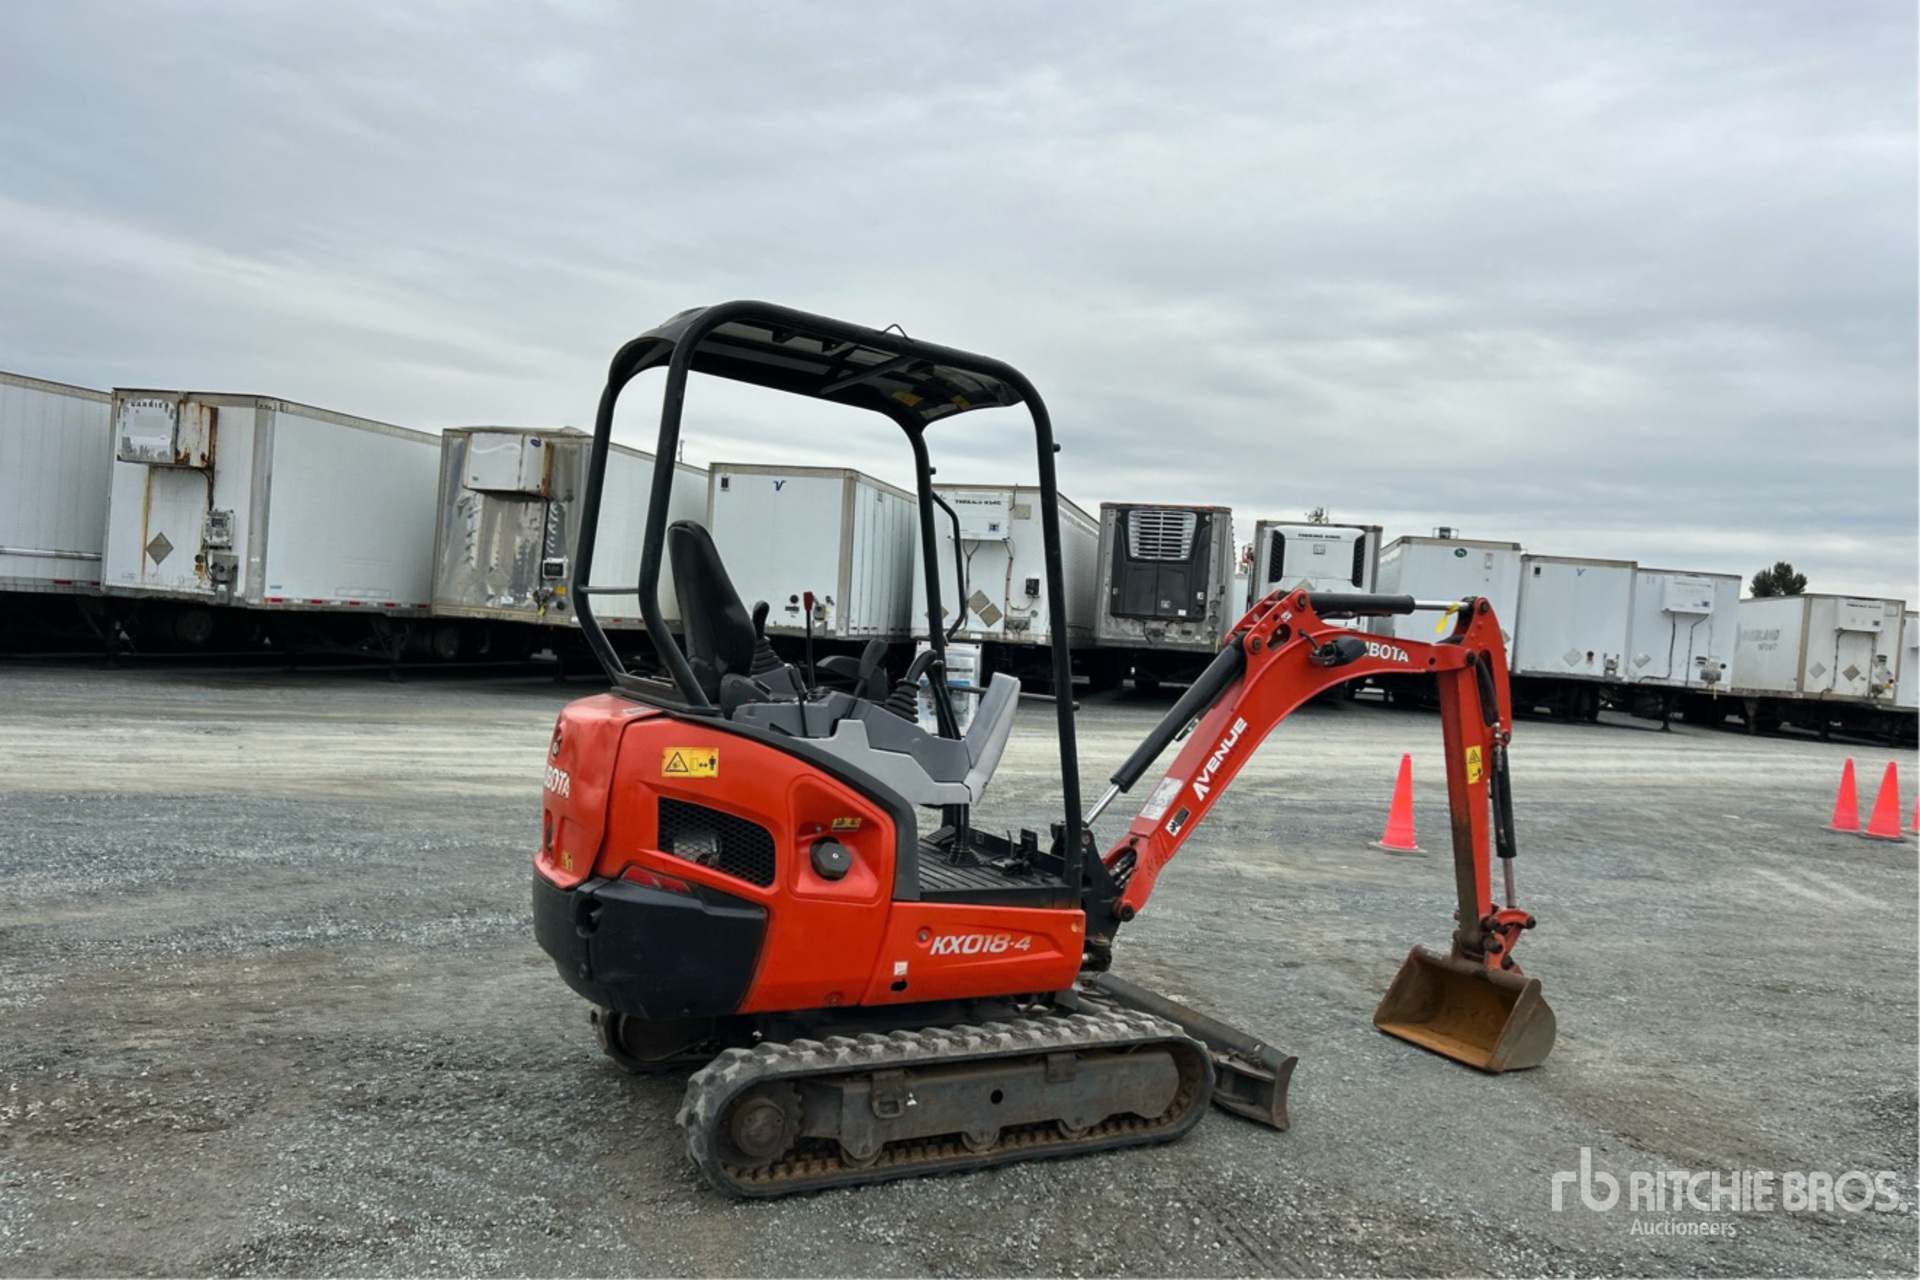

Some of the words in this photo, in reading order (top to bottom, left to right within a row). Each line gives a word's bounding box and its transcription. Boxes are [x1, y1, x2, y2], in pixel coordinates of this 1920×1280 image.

[1365, 641, 1409, 662] BOTA
[1193, 717, 1248, 801] AVENUE
[544, 765, 570, 798] BOTA
[930, 934, 1032, 955] KX018-4
